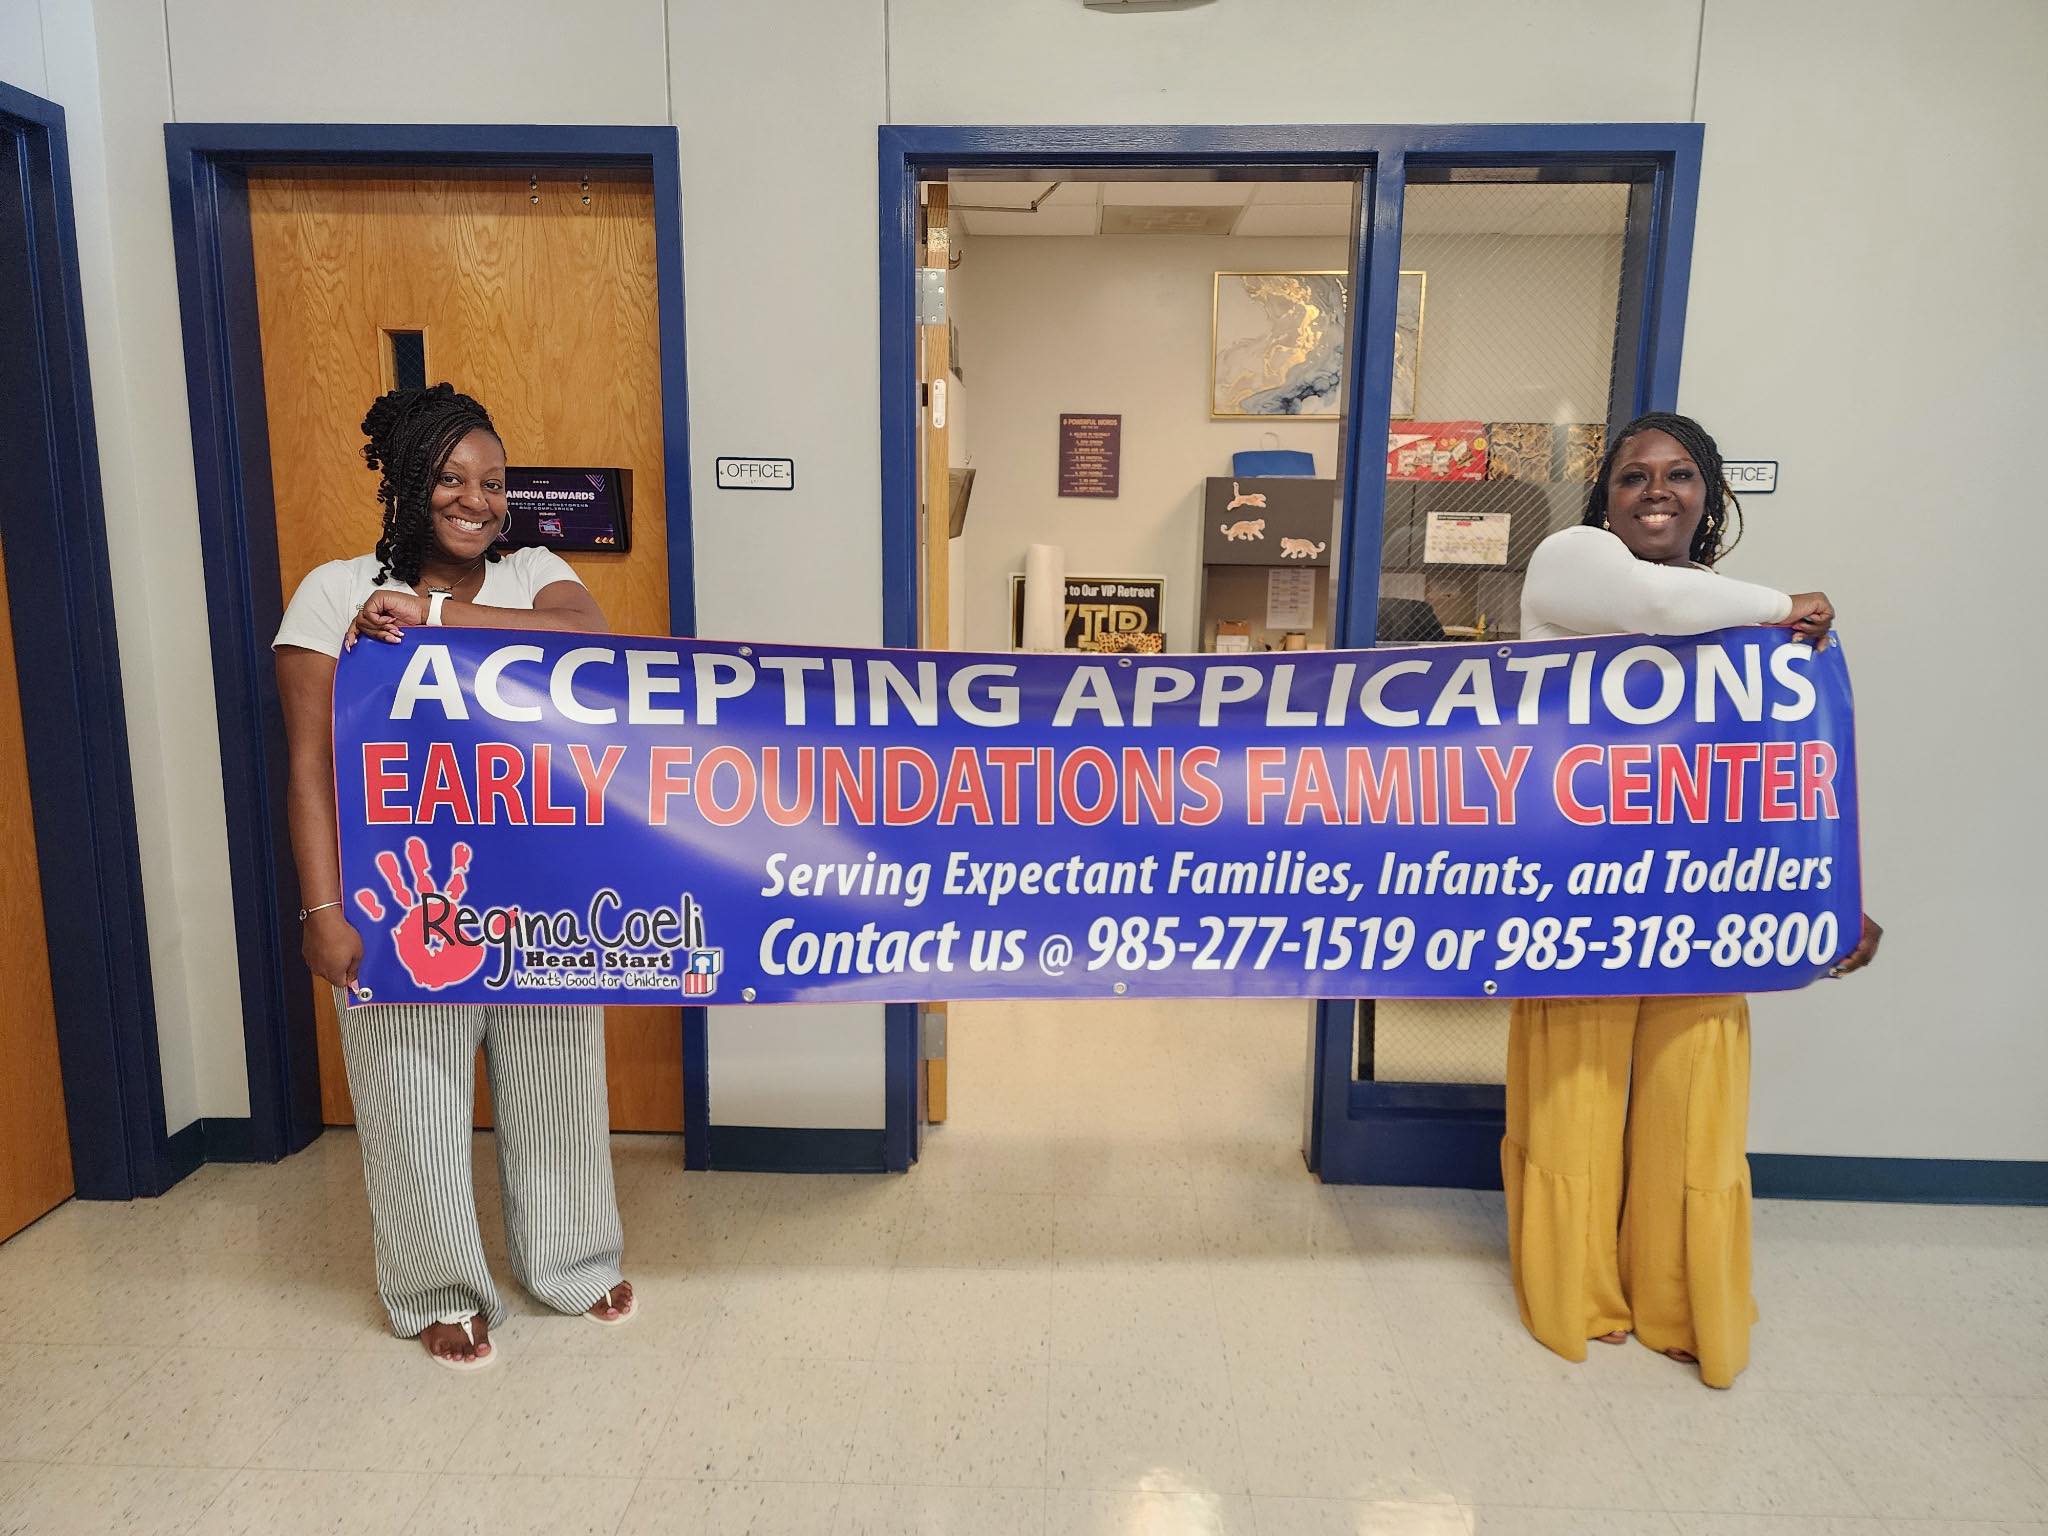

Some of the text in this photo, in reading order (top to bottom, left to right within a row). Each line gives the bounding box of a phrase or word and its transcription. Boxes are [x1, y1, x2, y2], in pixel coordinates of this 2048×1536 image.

[727, 463, 784, 479] OFFICE
[1720, 466, 1769, 481] FFICE
[505, 490, 595, 501] ANIQUA EDWARDS
[1069, 585, 1081, 597] to
[1081, 583, 1100, 597] Our
[1101, 584, 1117, 597] VIP
[1117, 585, 1156, 599] Retreat
[389, 643, 1817, 728] ACCEPTING APPLICATIONS
[361, 740, 1841, 827] EARLY FOUNDATIONS FAMILY CENTER
[760, 846, 1834, 908] Serving Expectant Families, Infants, and Toddlers
[419, 889, 705, 988] Regina Coeli
[758, 910, 1840, 977] Contact us @ 985-277-1519 or 985-318-8800
[525, 951, 672, 969] Head Start
[515, 971, 679, 989] What's Good for Children
